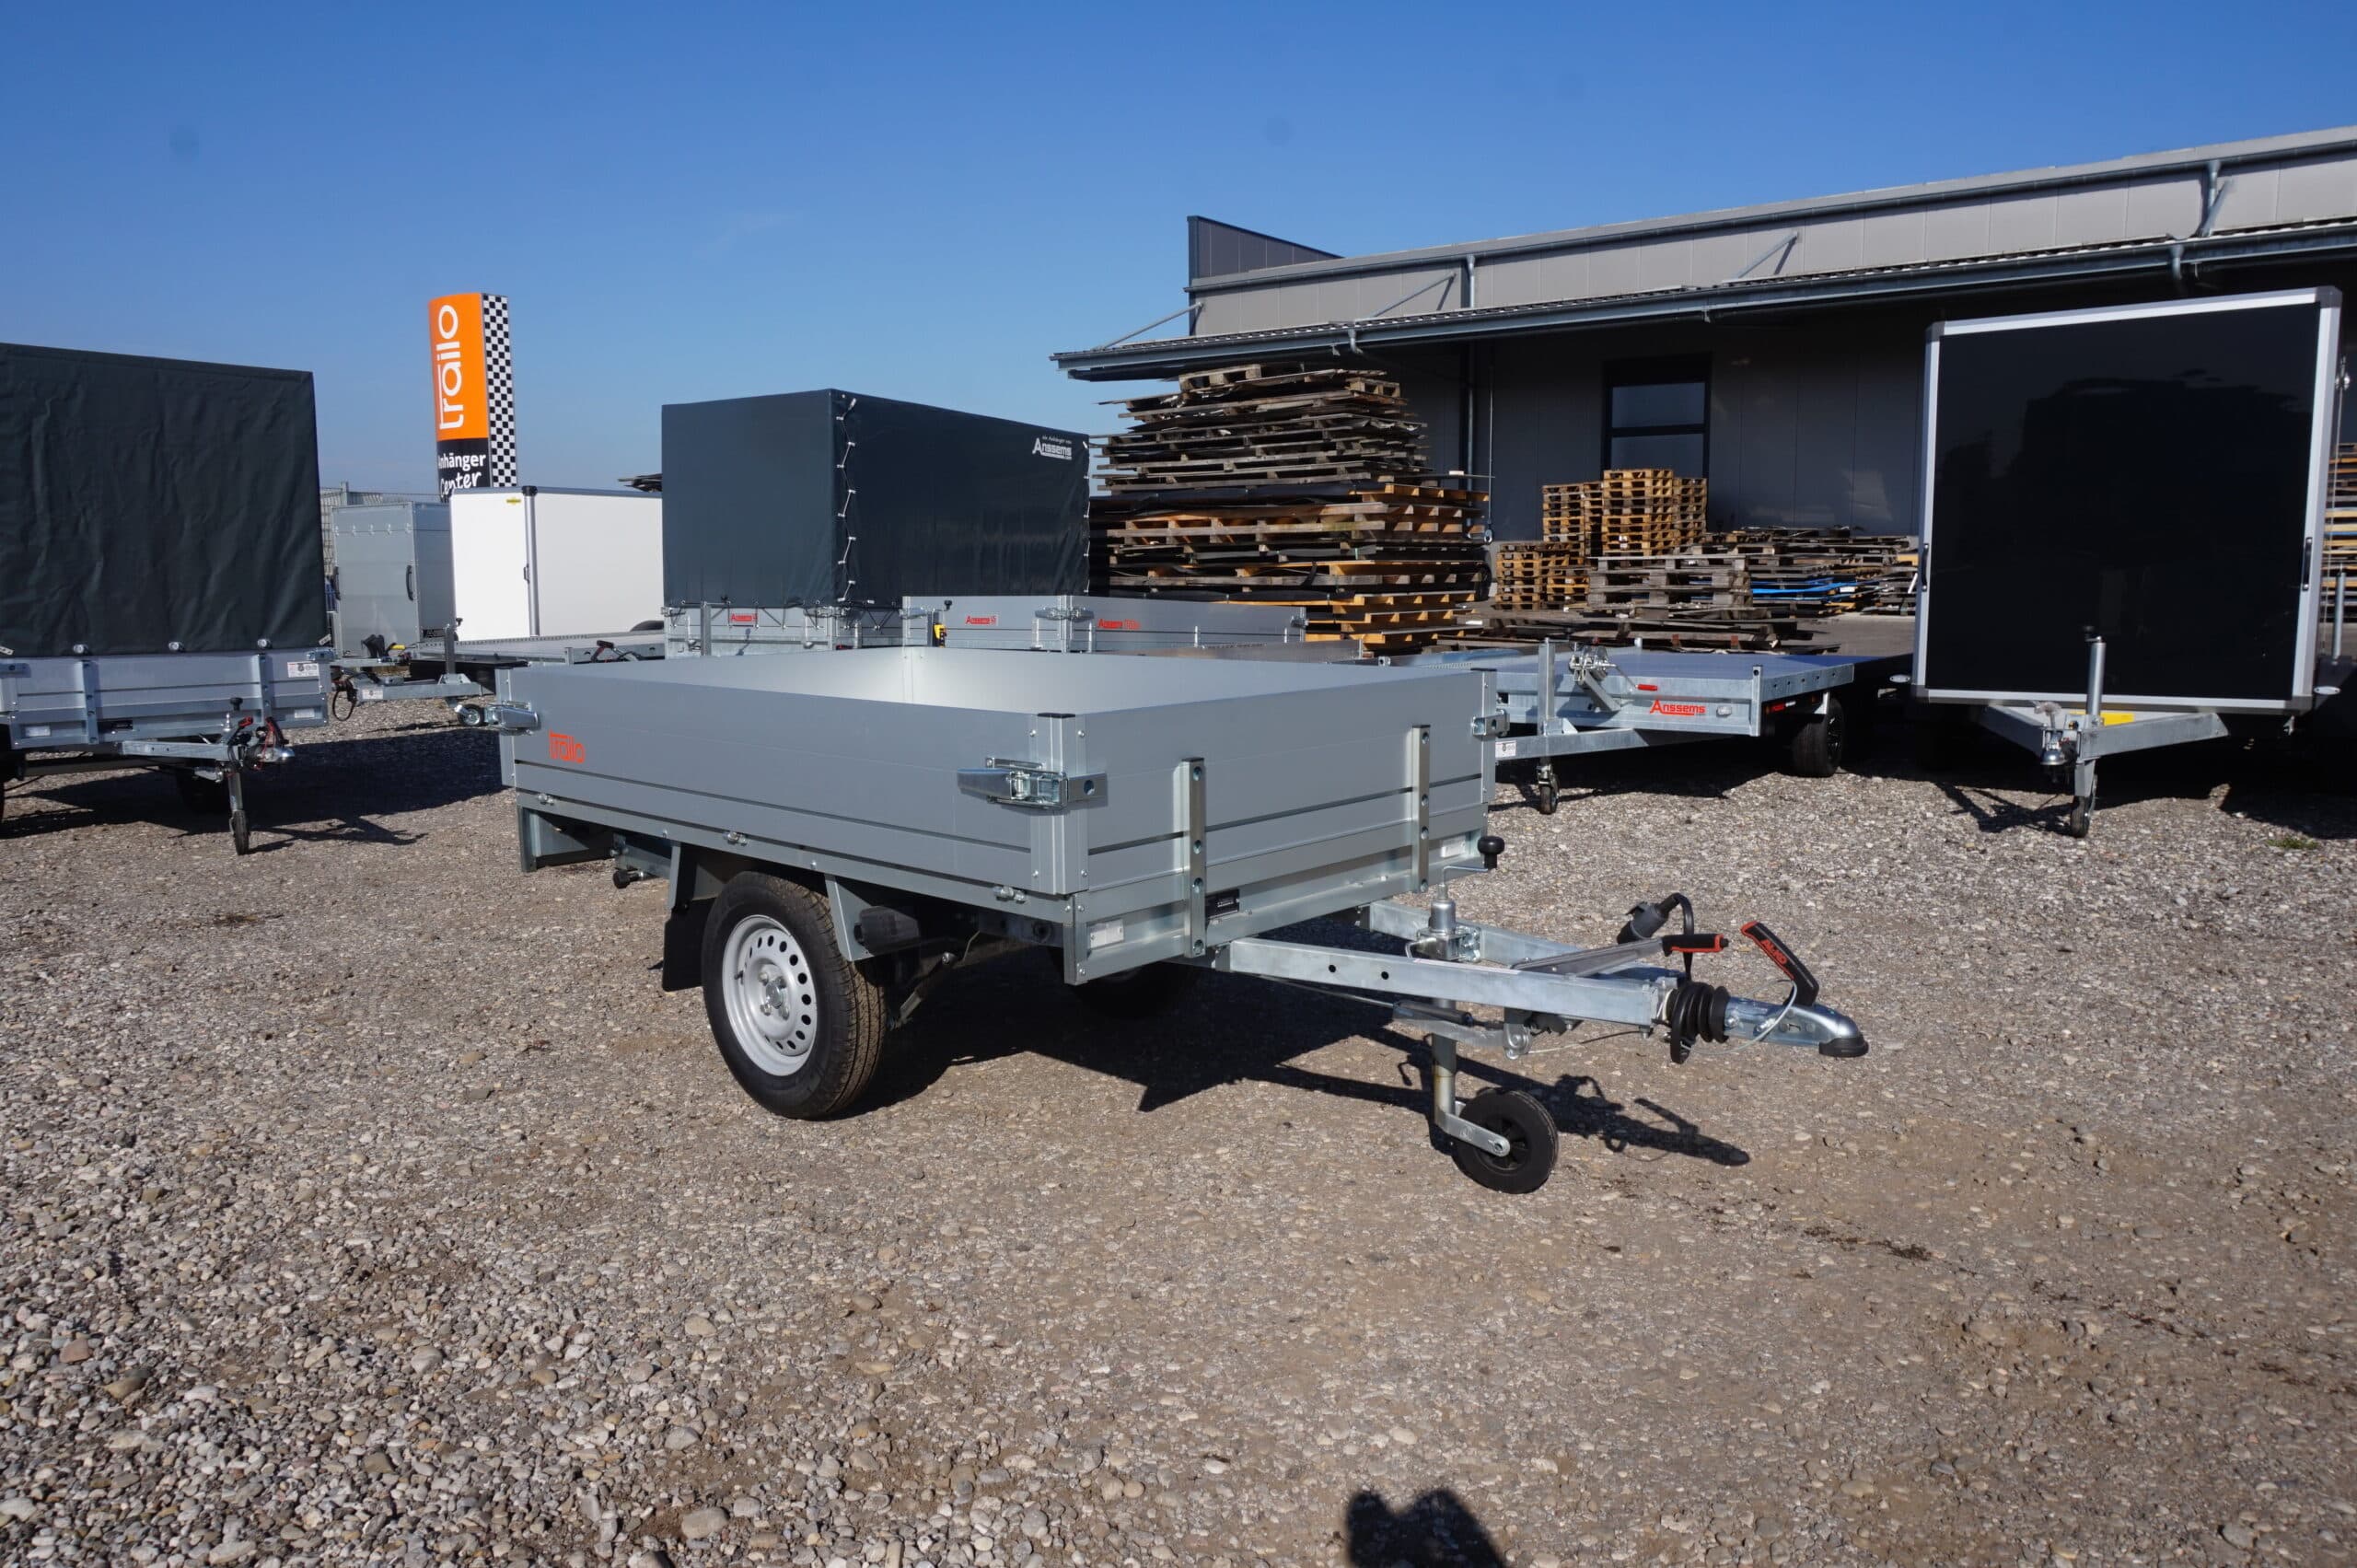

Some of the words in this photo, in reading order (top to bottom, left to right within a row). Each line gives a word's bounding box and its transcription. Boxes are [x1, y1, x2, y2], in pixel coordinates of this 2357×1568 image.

[435, 304, 464, 430] trailo
[1032, 437, 1072, 459] Anssems
[440, 471, 482, 498] Center
[1649, 699, 1707, 716] Anssems
[549, 728, 586, 764] trailo
